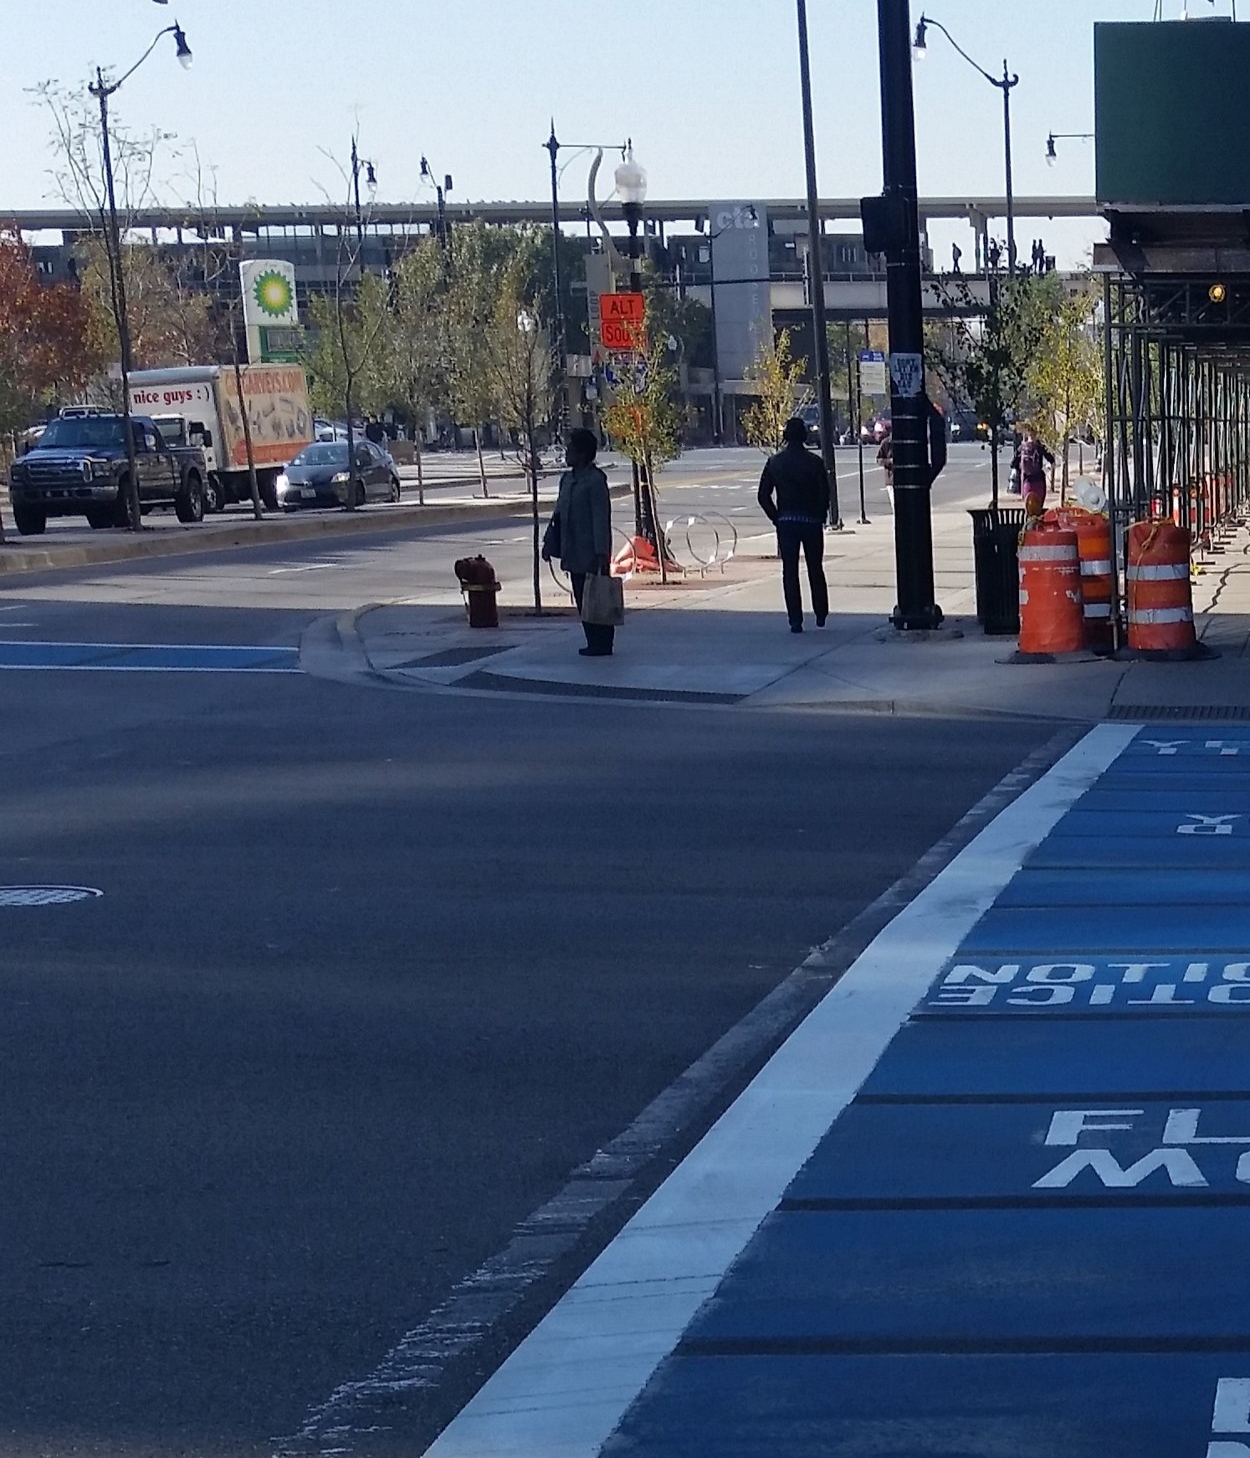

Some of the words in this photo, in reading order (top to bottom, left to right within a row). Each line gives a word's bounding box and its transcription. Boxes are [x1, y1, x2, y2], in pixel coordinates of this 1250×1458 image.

[610, 300, 635, 314] ALT
[134, 390, 159, 404] nice
[163, 388, 193, 406] guys
